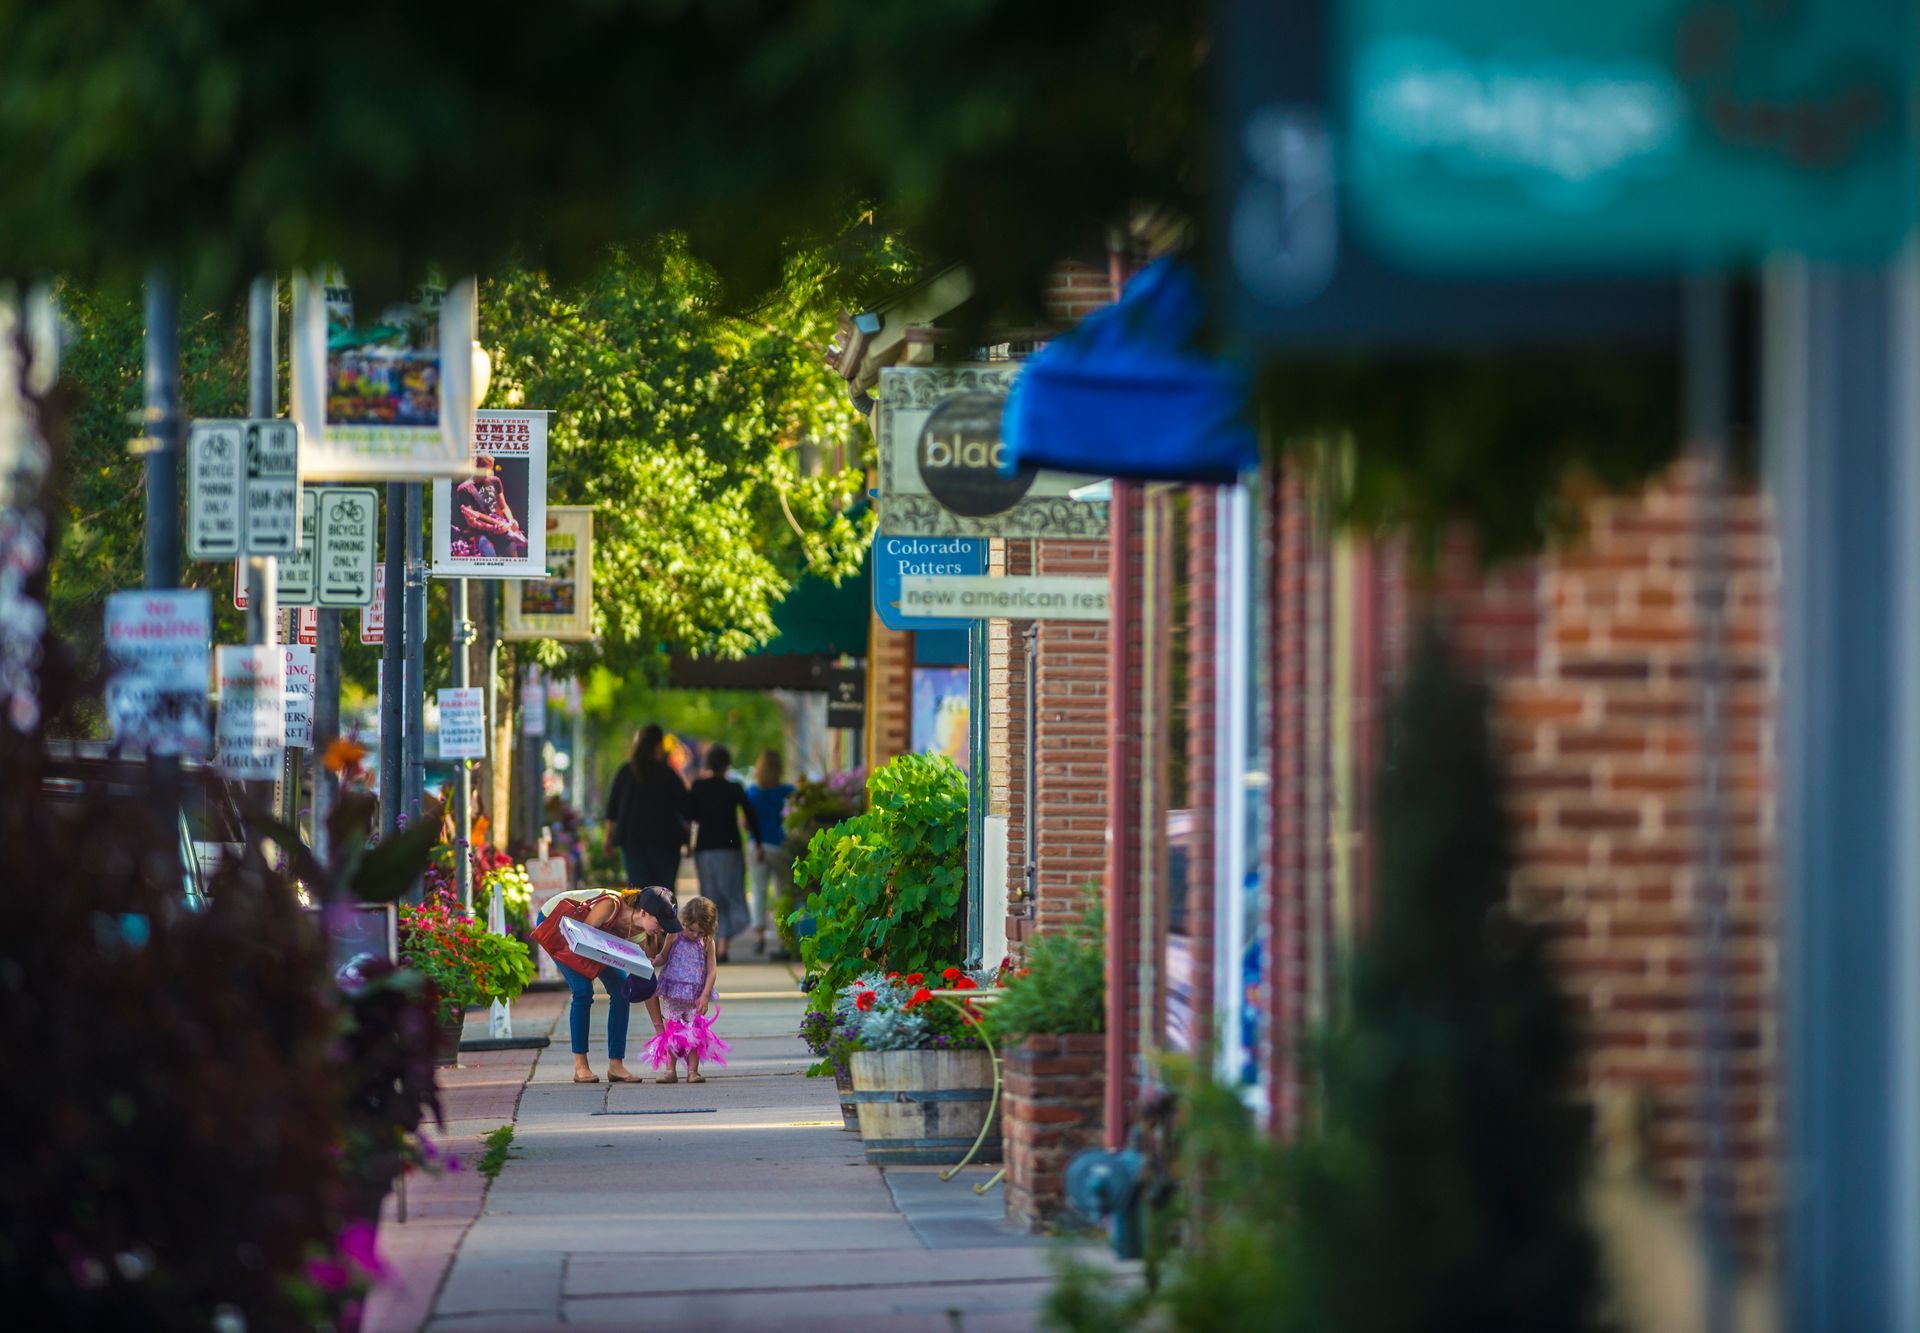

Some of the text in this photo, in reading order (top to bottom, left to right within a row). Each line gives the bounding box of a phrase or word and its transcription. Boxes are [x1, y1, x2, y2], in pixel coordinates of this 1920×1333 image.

[475, 424, 530, 434] MMER
[476, 434, 530, 442] USIC
[472, 442, 529, 451] STIVALS
[926, 432, 1008, 469] blac
[328, 524, 365, 536] BICYCLE
[328, 541, 365, 552] PARKING
[887, 538, 972, 555] Colorado
[333, 556, 358, 567] ONLY
[898, 560, 962, 575] Potters
[328, 571, 364, 583] ALL TIMES
[907, 588, 1106, 608] new american res
